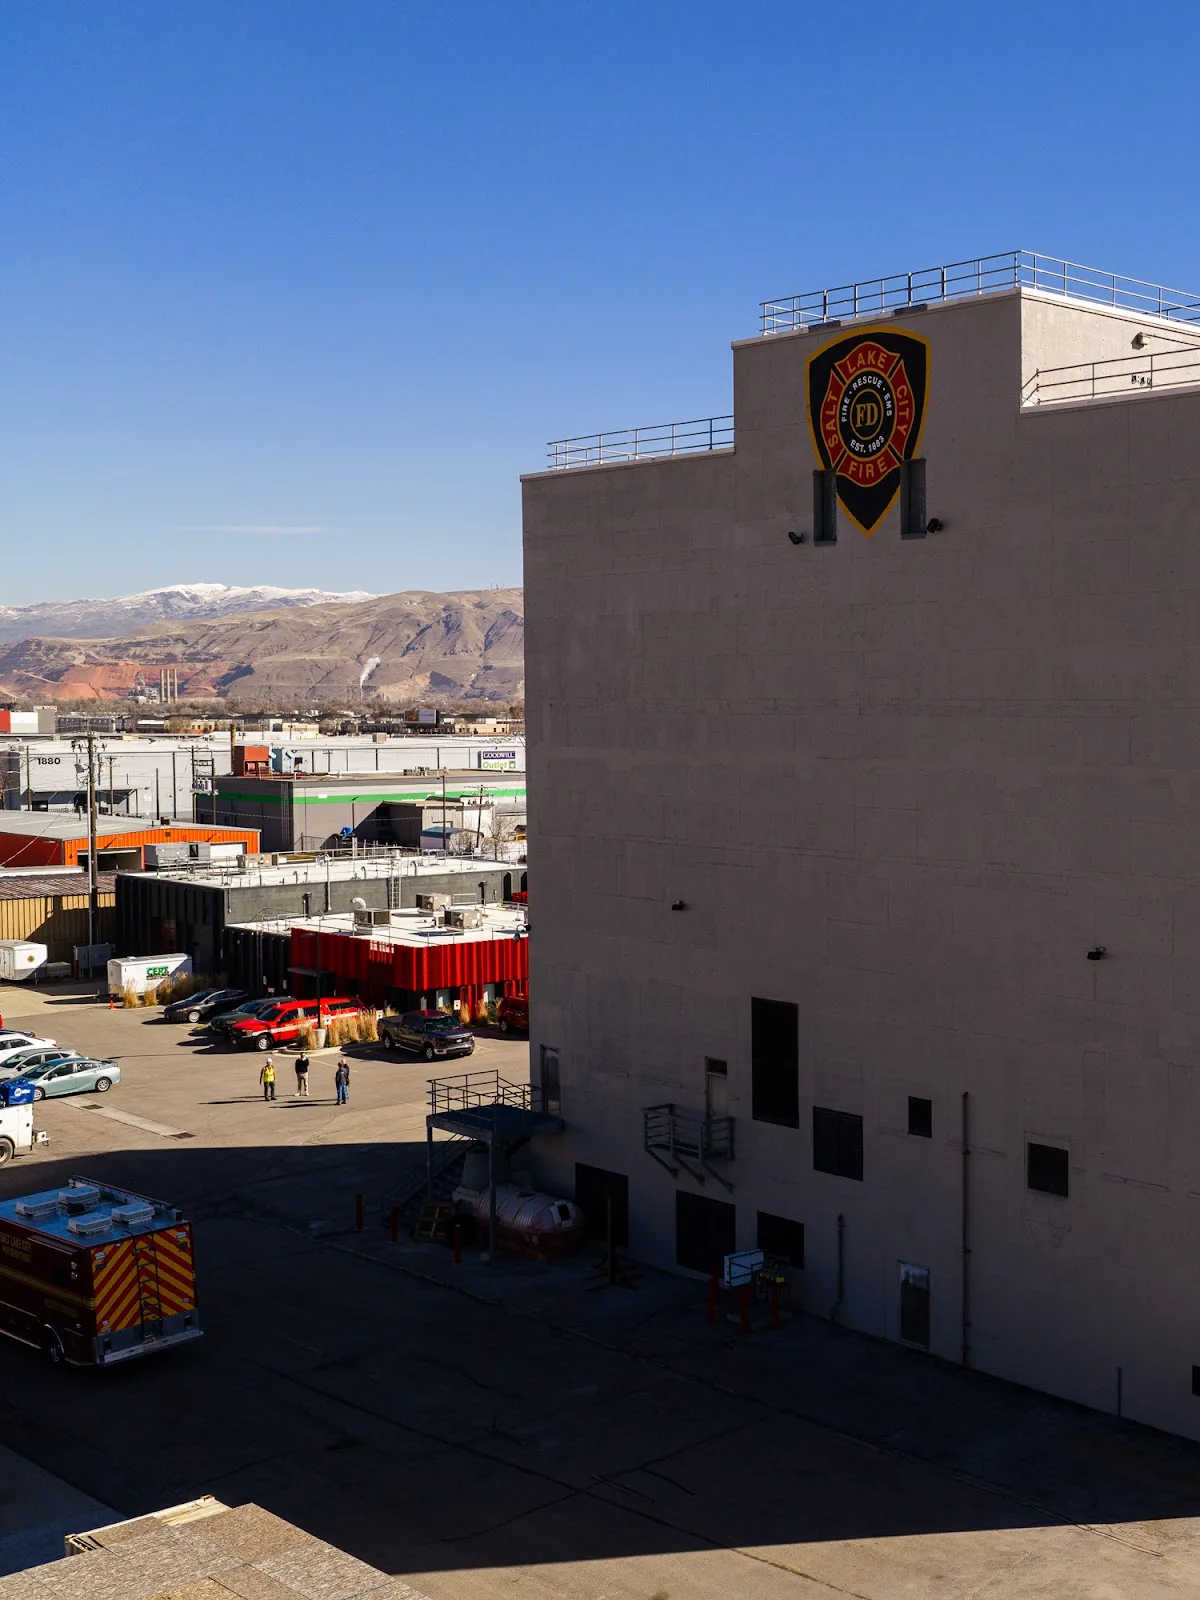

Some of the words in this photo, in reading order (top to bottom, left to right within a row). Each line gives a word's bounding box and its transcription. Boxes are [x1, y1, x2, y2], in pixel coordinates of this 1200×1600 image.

[825, 390, 839, 448] SALT
[846, 350, 888, 374] LAKE
[896, 384, 909, 436] CITY
[841, 396, 850, 423] FIRE
[852, 375, 883, 391] RESCUE
[884, 393, 893, 417] EMS
[855, 402, 879, 428] FD
[848, 457, 888, 479] FIRE
[38, 757, 61, 765] 1880
[482, 760, 508, 769] Outlet
